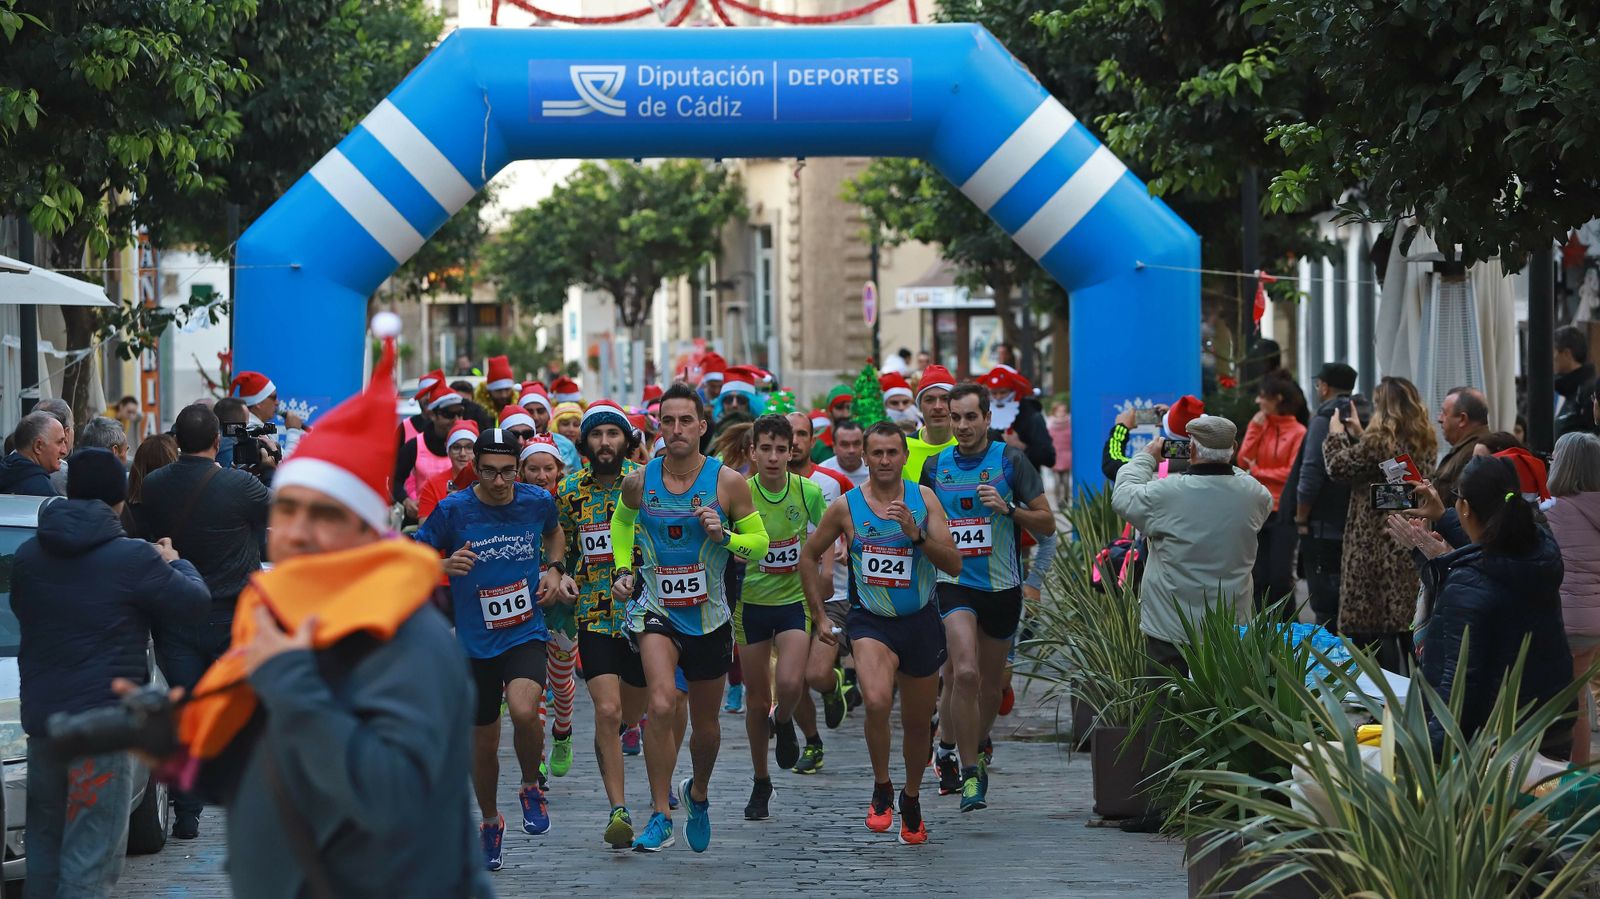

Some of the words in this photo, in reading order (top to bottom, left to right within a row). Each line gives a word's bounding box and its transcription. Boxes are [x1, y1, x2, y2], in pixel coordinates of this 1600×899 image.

[637, 64, 765, 90] Diputación
[788, 68, 899, 86] DEPORTES
[638, 96, 667, 117] de
[676, 95, 742, 117] Cádiz
[585, 534, 611, 551] 04
[951, 529, 985, 545] 044
[764, 548, 798, 563] 043
[867, 557, 905, 575] 024
[661, 577, 700, 595] 045
[488, 594, 526, 616] 016
